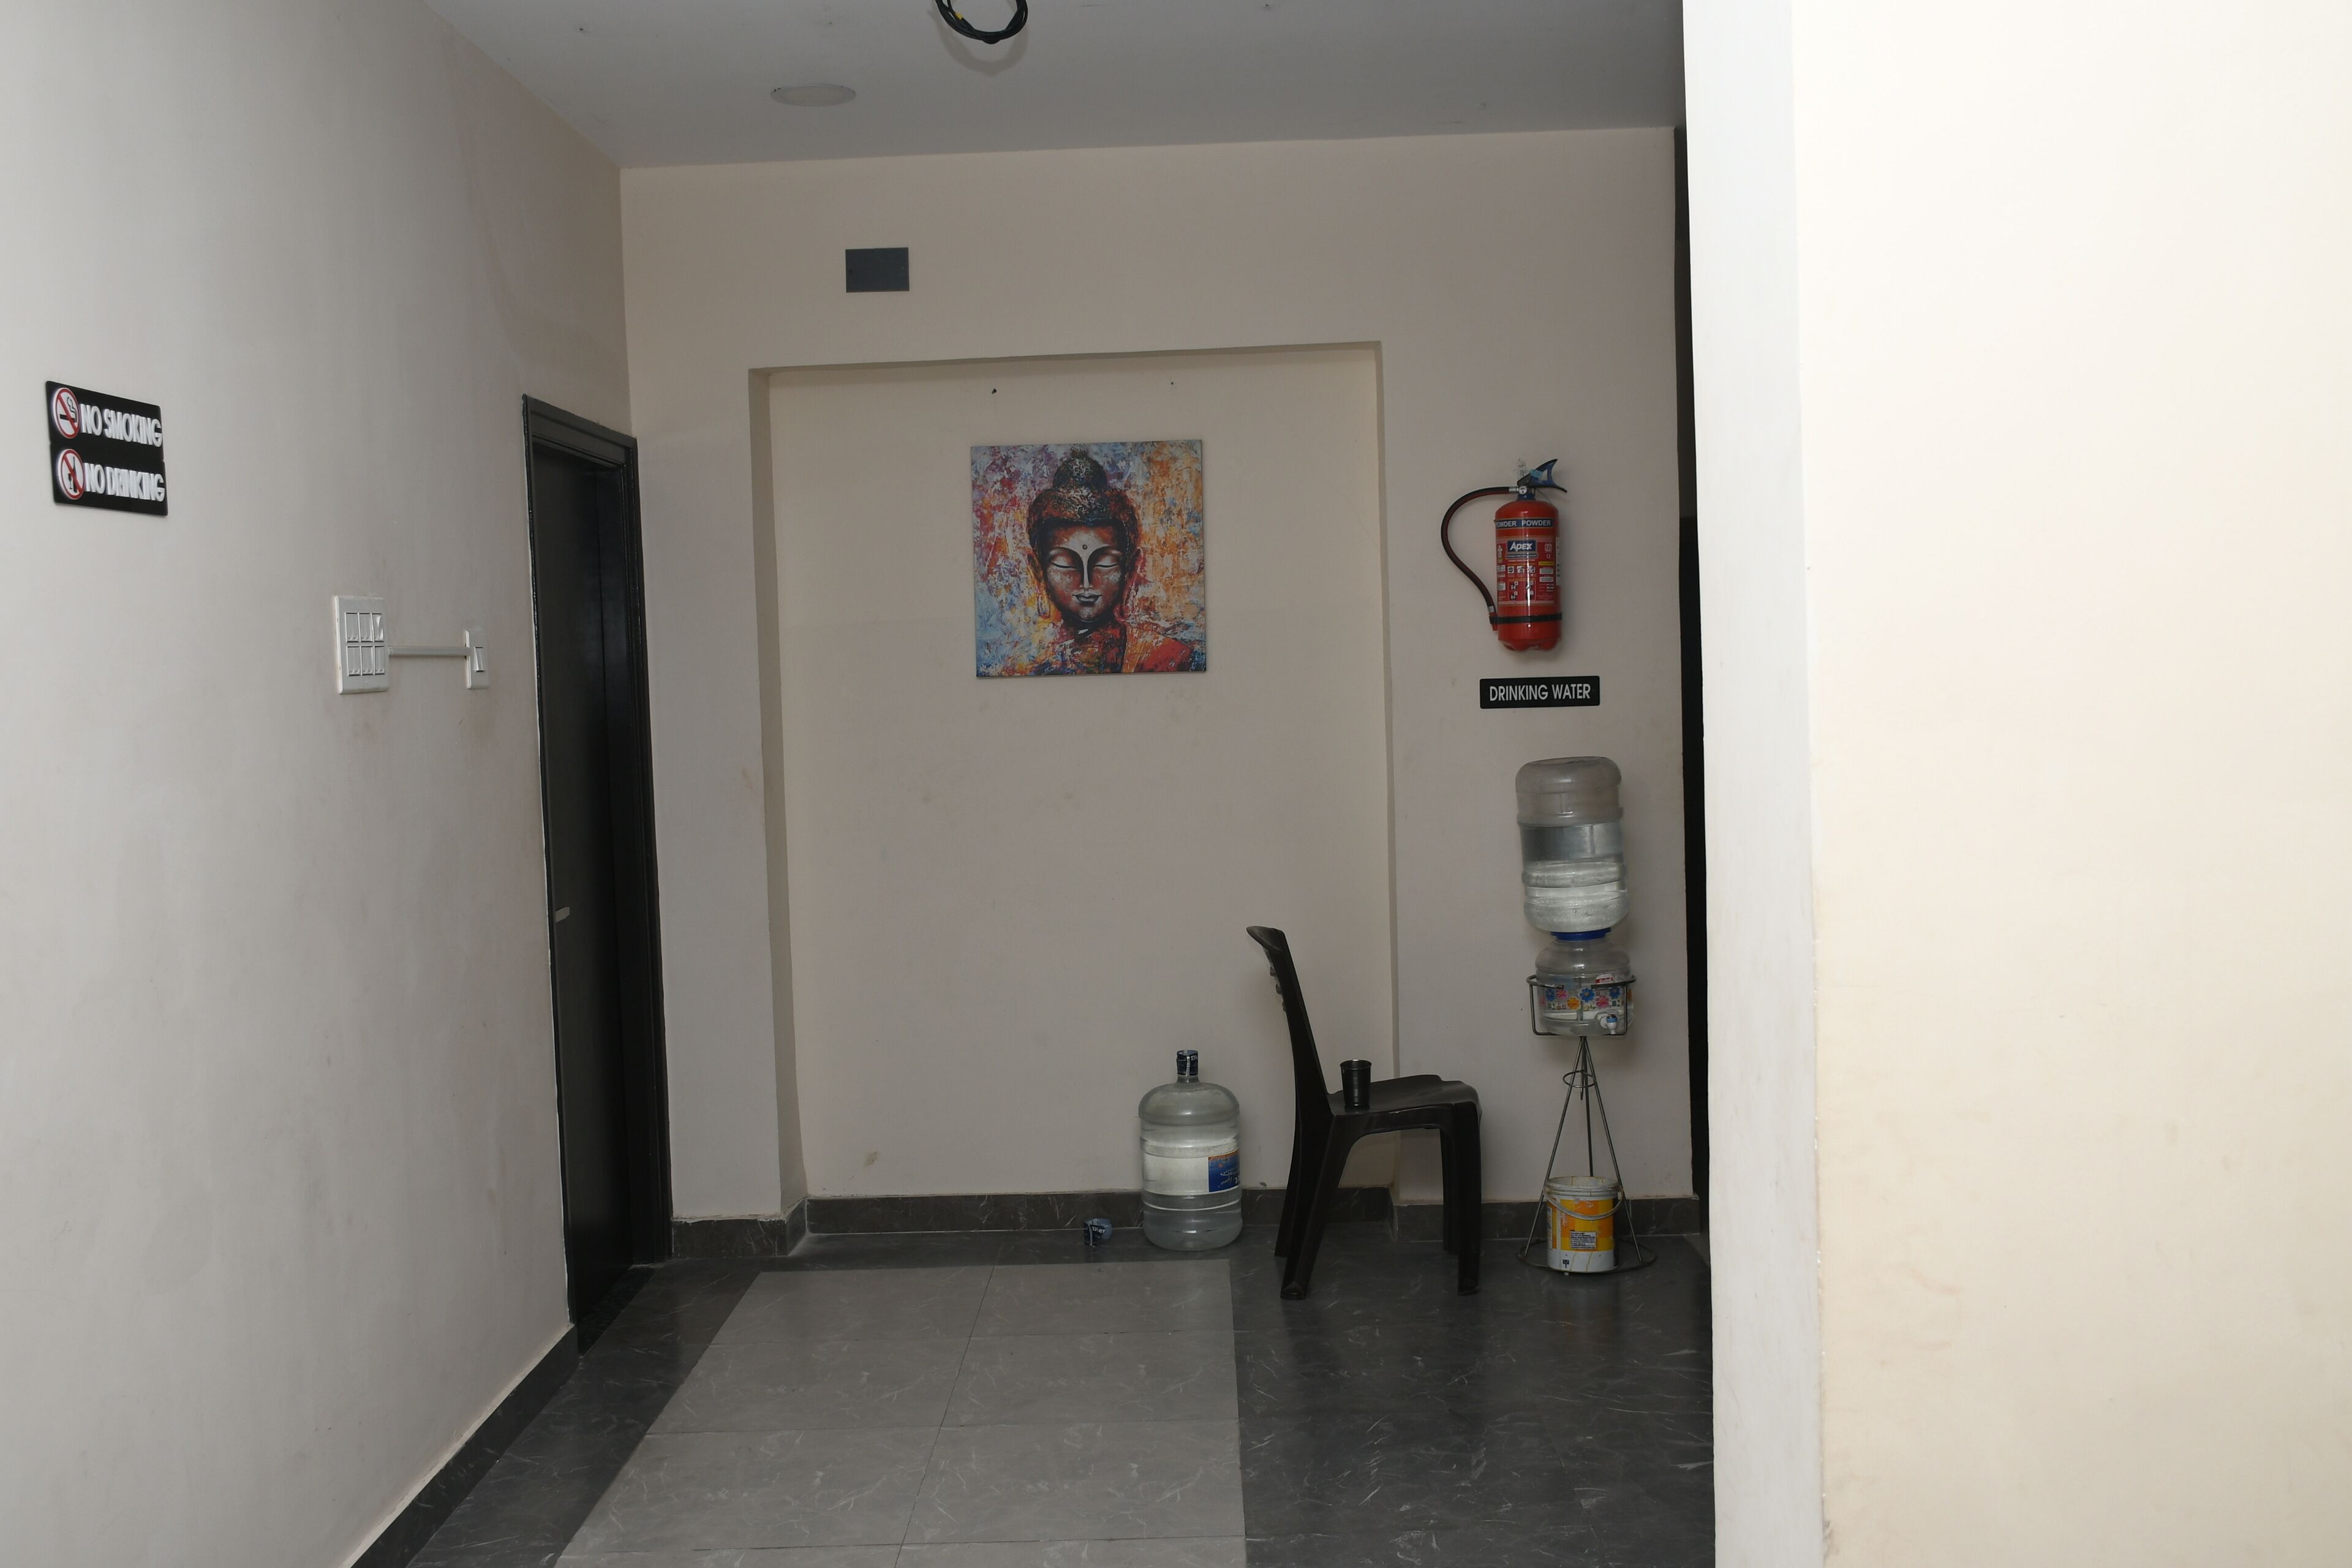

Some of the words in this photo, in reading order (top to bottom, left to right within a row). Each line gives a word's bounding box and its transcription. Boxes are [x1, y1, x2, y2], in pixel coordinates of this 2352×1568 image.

[80, 404, 102, 435] NO
[104, 409, 162, 447] SMOKING
[84, 463, 105, 494] NO
[106, 466, 165, 502] DRINKING
[1490, 684, 1548, 701] DRINKING
[1551, 684, 1591, 699] WATER
